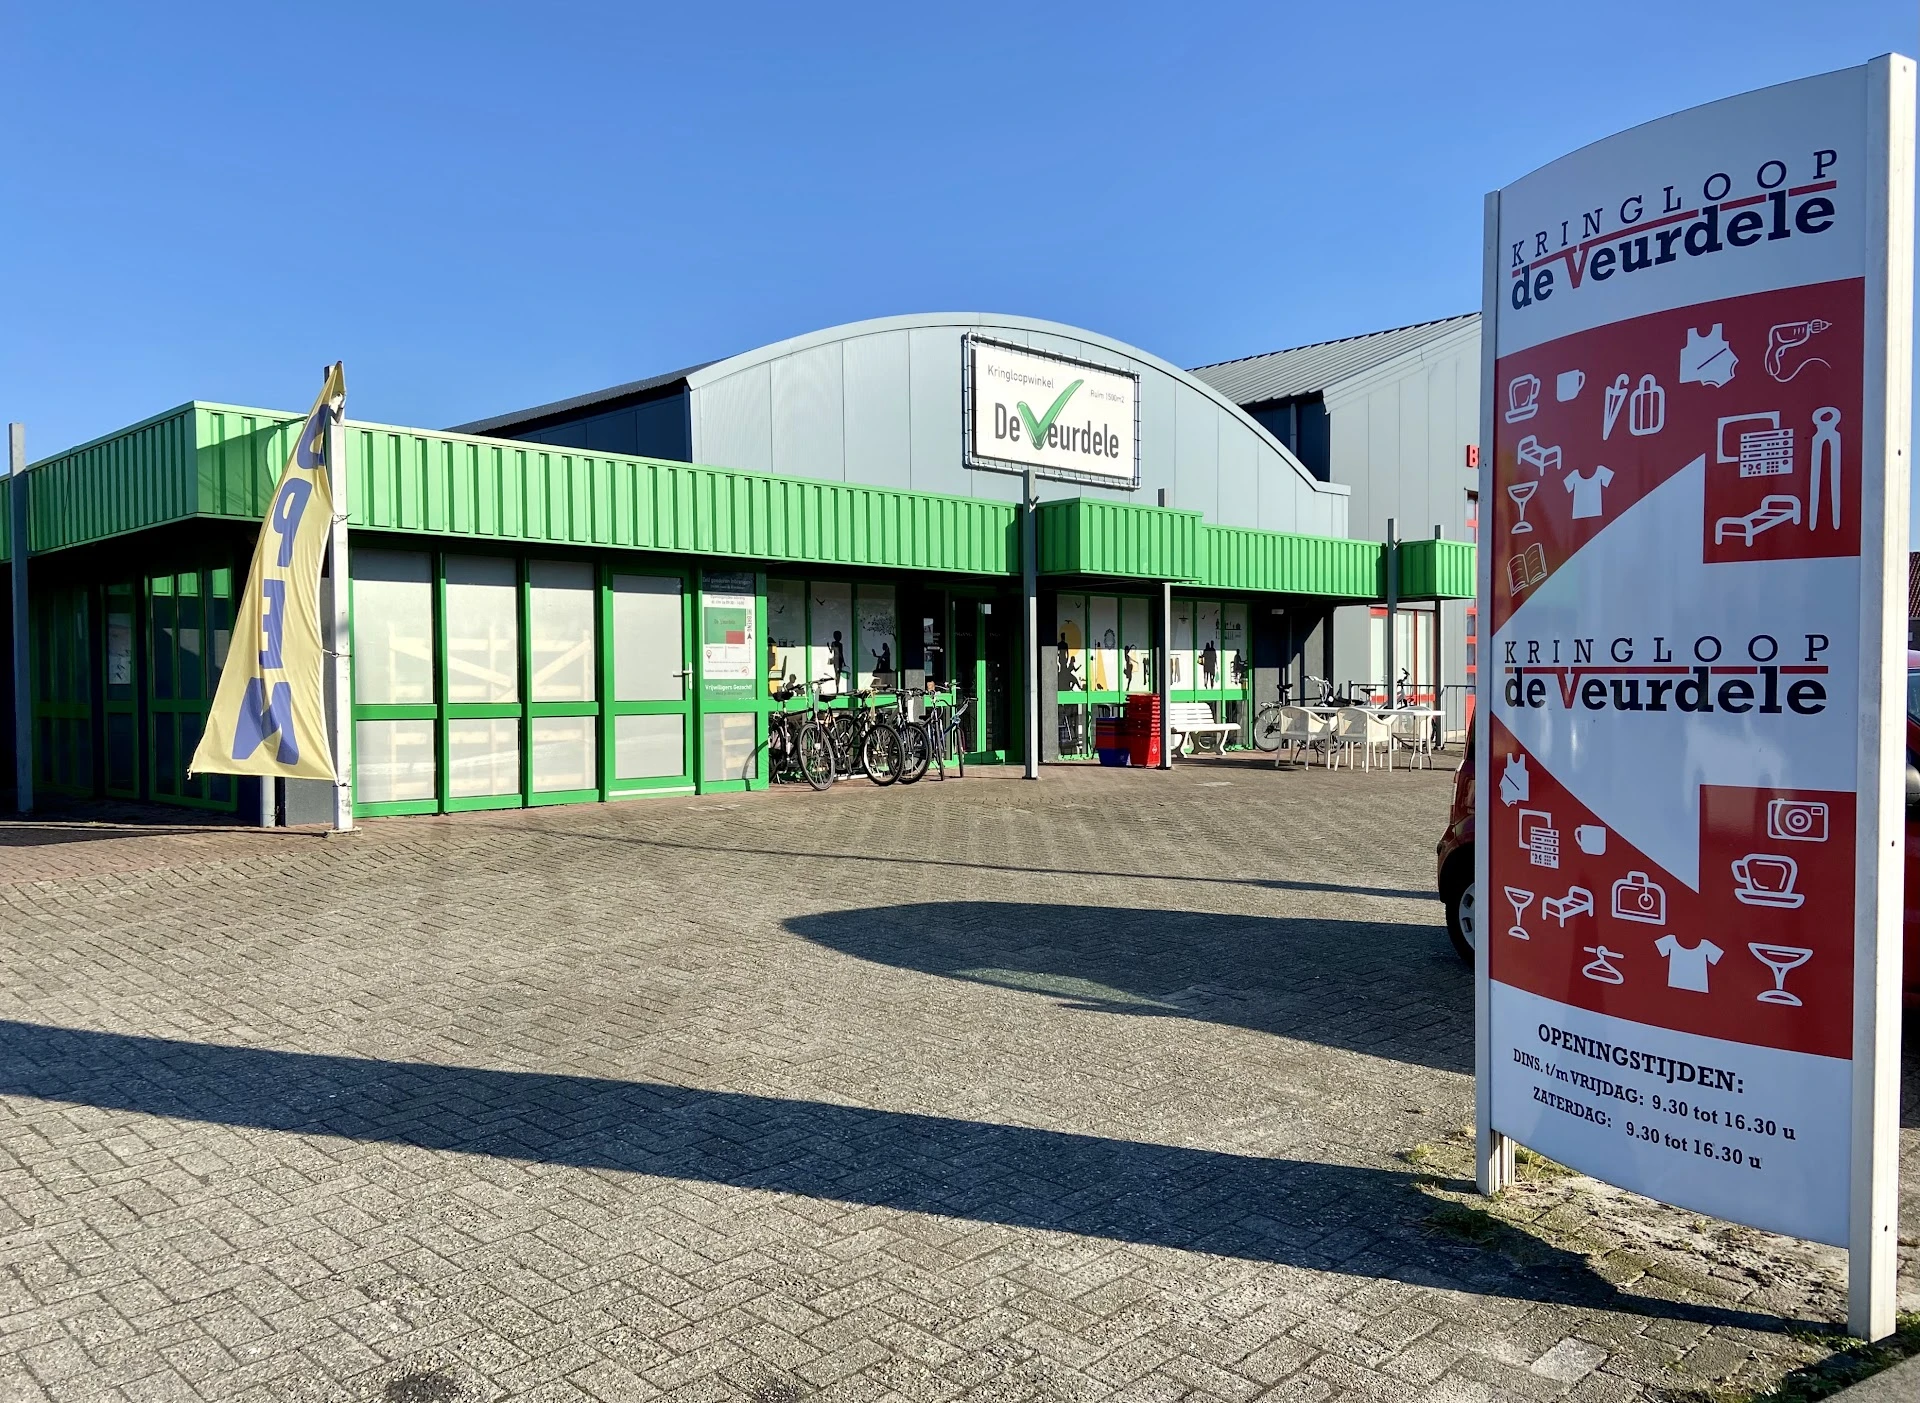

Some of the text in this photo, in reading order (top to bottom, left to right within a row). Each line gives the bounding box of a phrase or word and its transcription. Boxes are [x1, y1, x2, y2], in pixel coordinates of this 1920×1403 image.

[1511, 149, 1838, 268] KRINGLOOP
[1511, 189, 1836, 310] de Veurdele
[987, 364, 1054, 389] Kringloopwinkel
[994, 402, 1021, 442] De
[1504, 634, 1829, 664] KRINGLOOP
[1504, 665, 1828, 715] de Veurdele
[1538, 1023, 1745, 1094] OPENINGSTIJDEN:
[1513, 1048, 1796, 1141] DINS. t/m VRIJDAG: 9.30 tot 16.30 u
[1533, 1086, 1762, 1170] ZATERDAG: 9.30 tot 16.30 u
